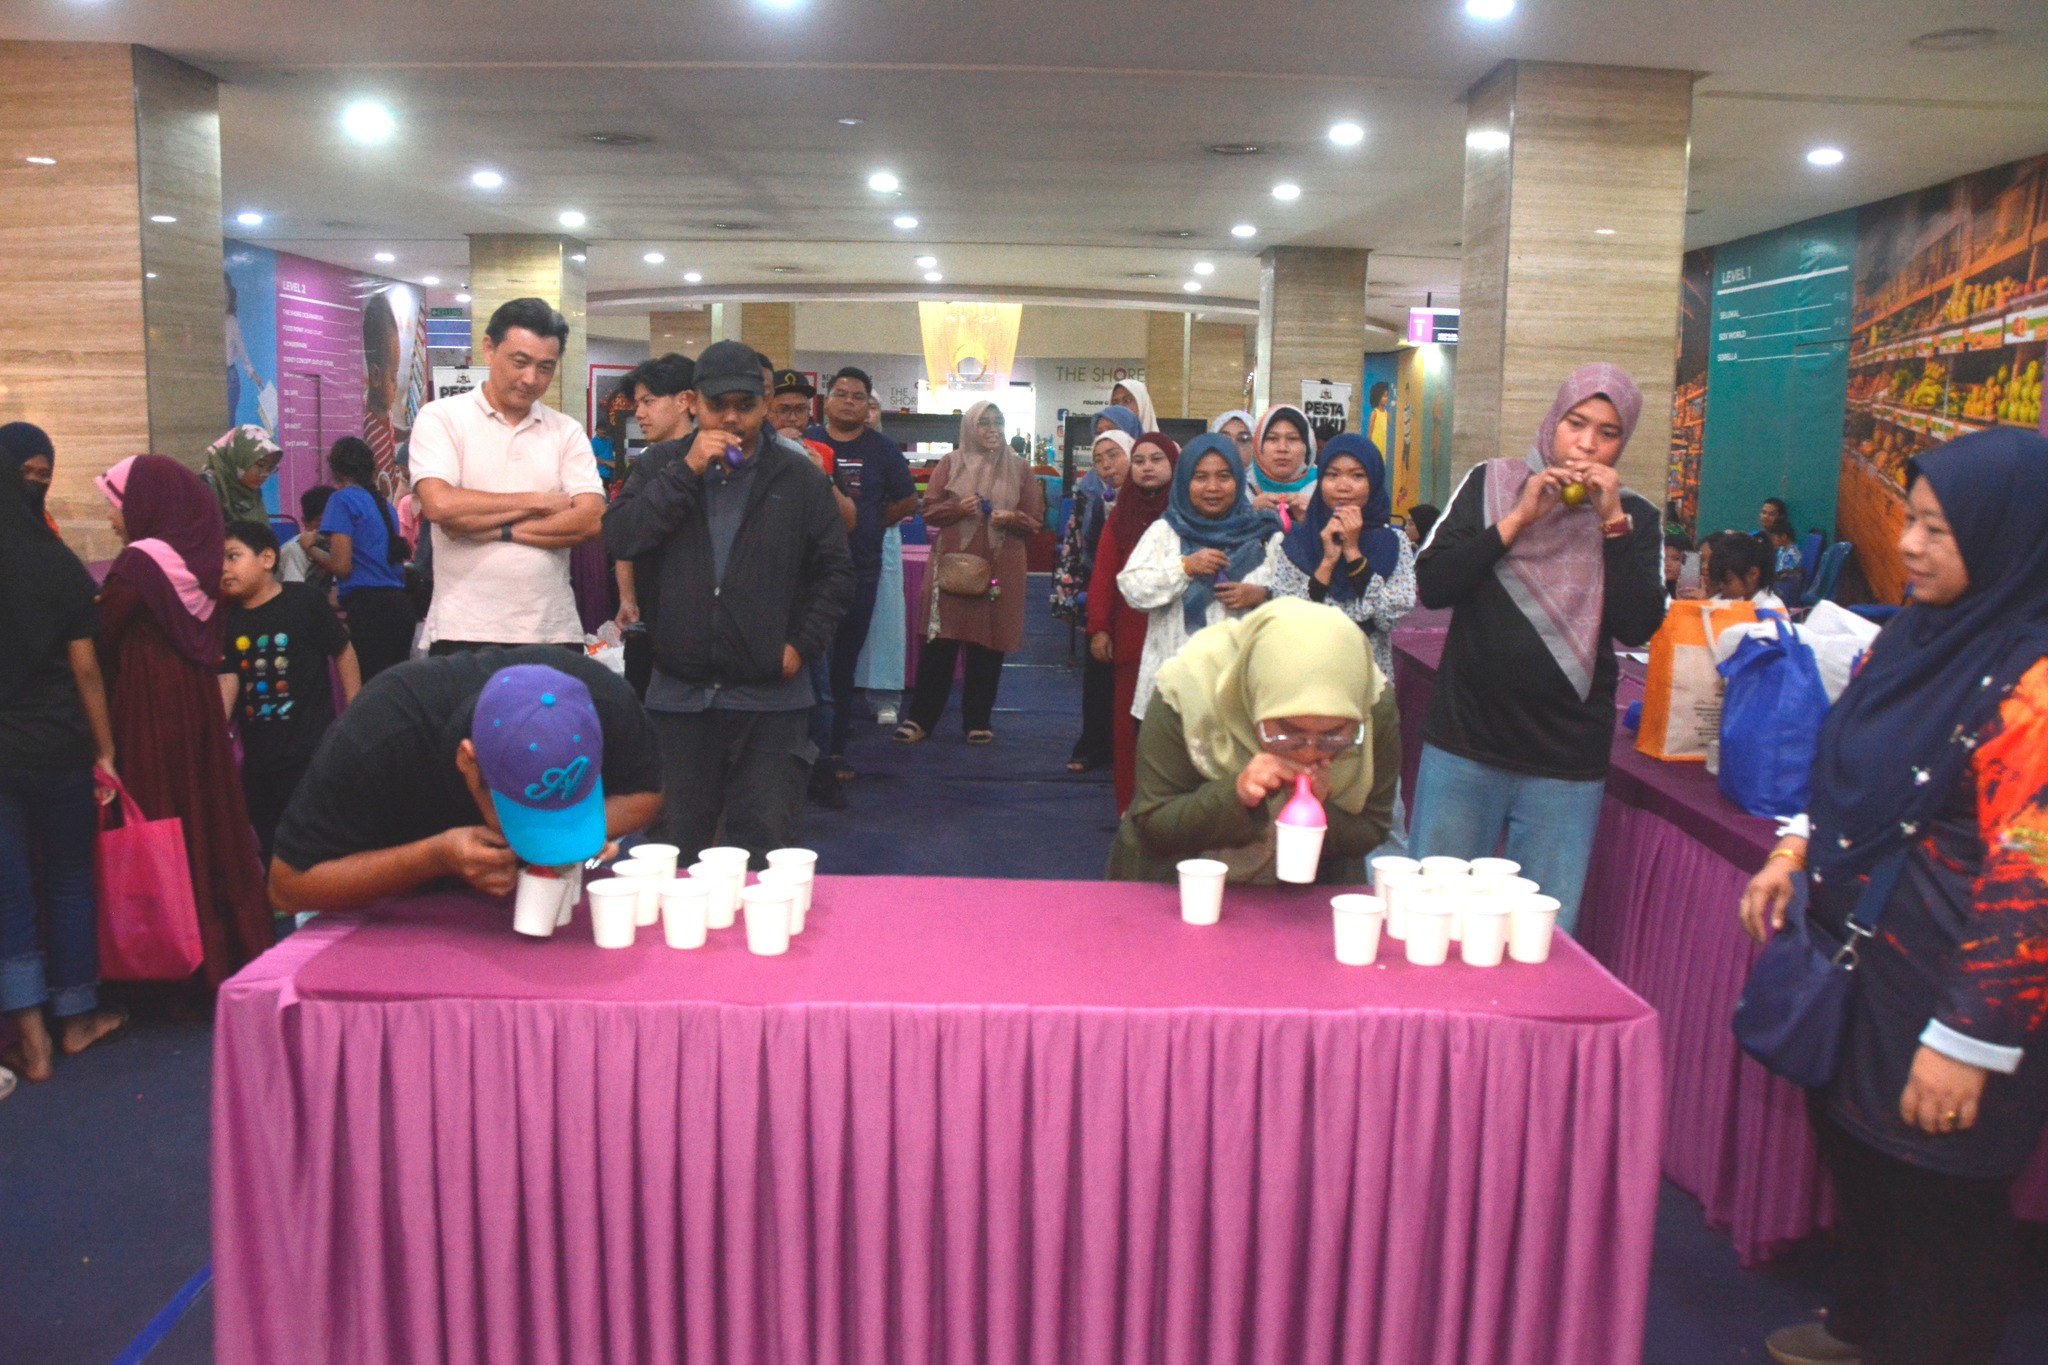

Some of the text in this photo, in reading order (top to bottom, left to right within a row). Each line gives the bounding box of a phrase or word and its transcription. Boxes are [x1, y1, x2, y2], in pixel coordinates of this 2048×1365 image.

[1722, 268, 1746, 284] LEVEL
[282, 281, 301, 293] LEVEL
[1056, 367, 1145, 382] THE SHORE
[439, 386, 475, 399] PES
[890, 387, 908, 396] THE
[890, 396, 918, 406] SHOR
[1304, 401, 1344, 417] PESTA
